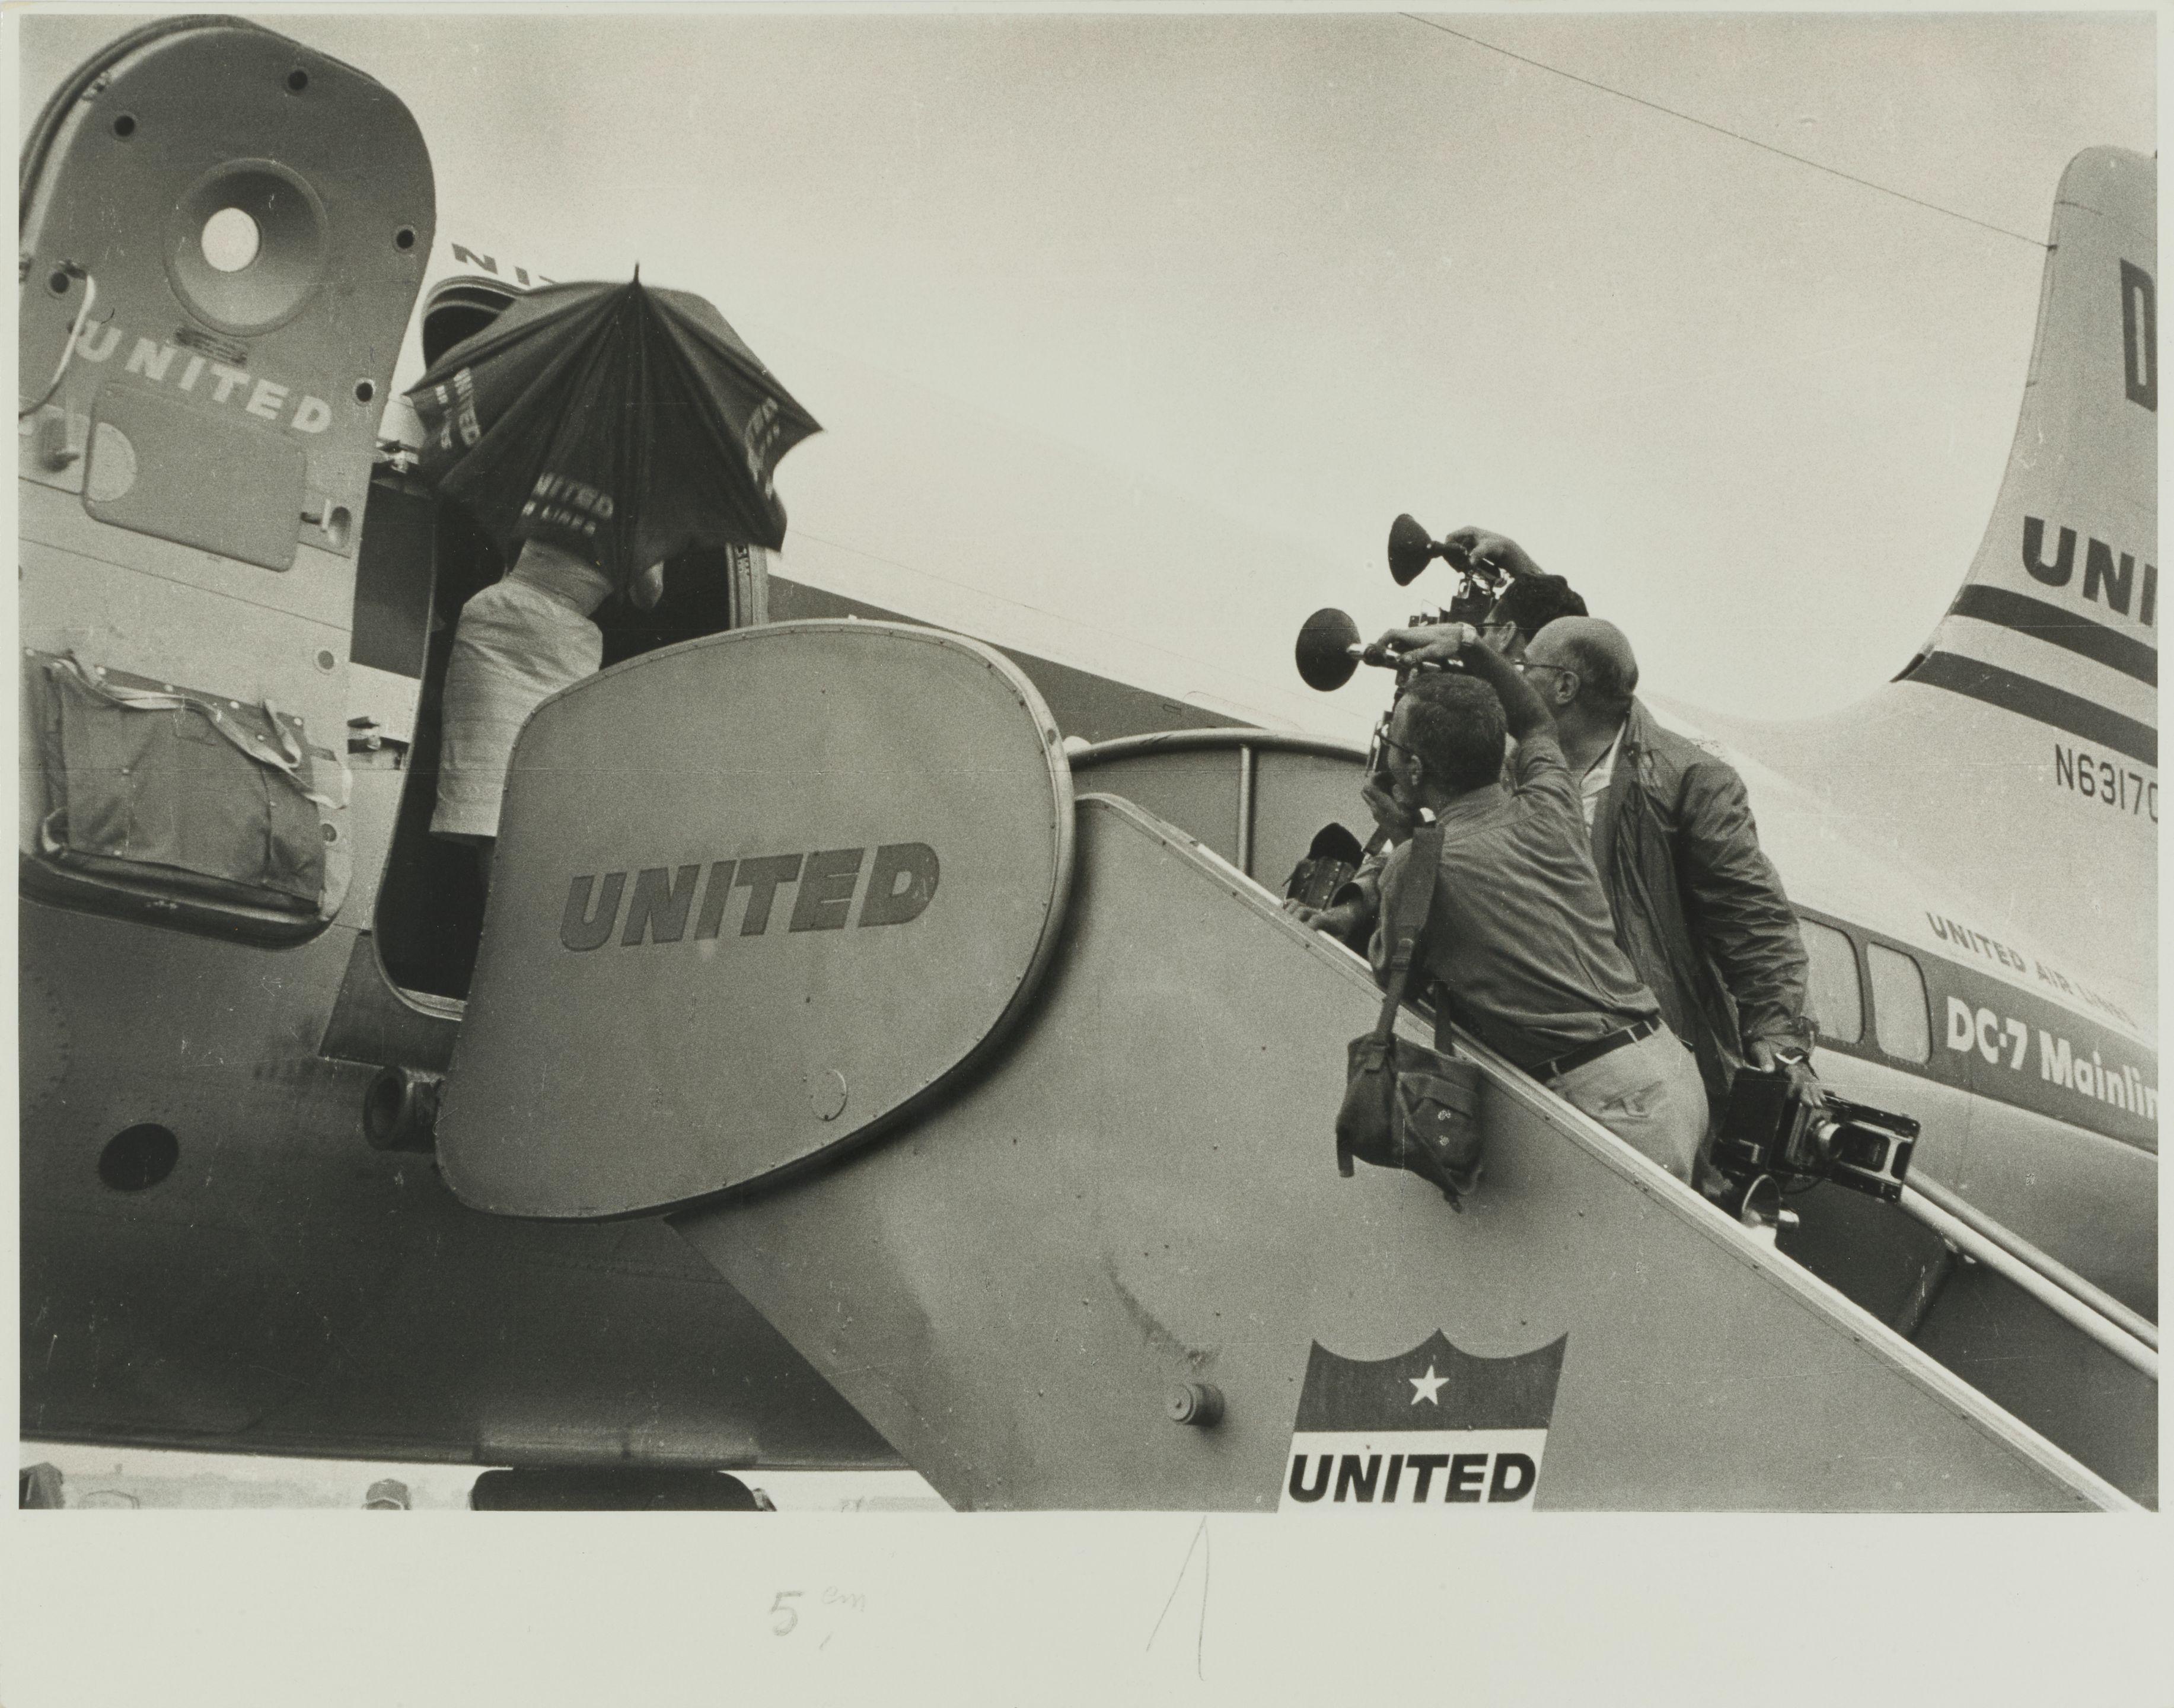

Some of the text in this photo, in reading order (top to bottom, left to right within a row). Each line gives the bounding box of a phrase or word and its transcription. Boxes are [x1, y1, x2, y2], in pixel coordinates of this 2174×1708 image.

[451, 243, 559, 287] NI
[75, 319, 333, 434] UNITED
[560, 842, 941, 952] UNITED
[1926, 911, 2026, 973] UNITED
[1947, 995, 2028, 1070] DC-7
[1288, 1452, 1537, 1503] UNITED
